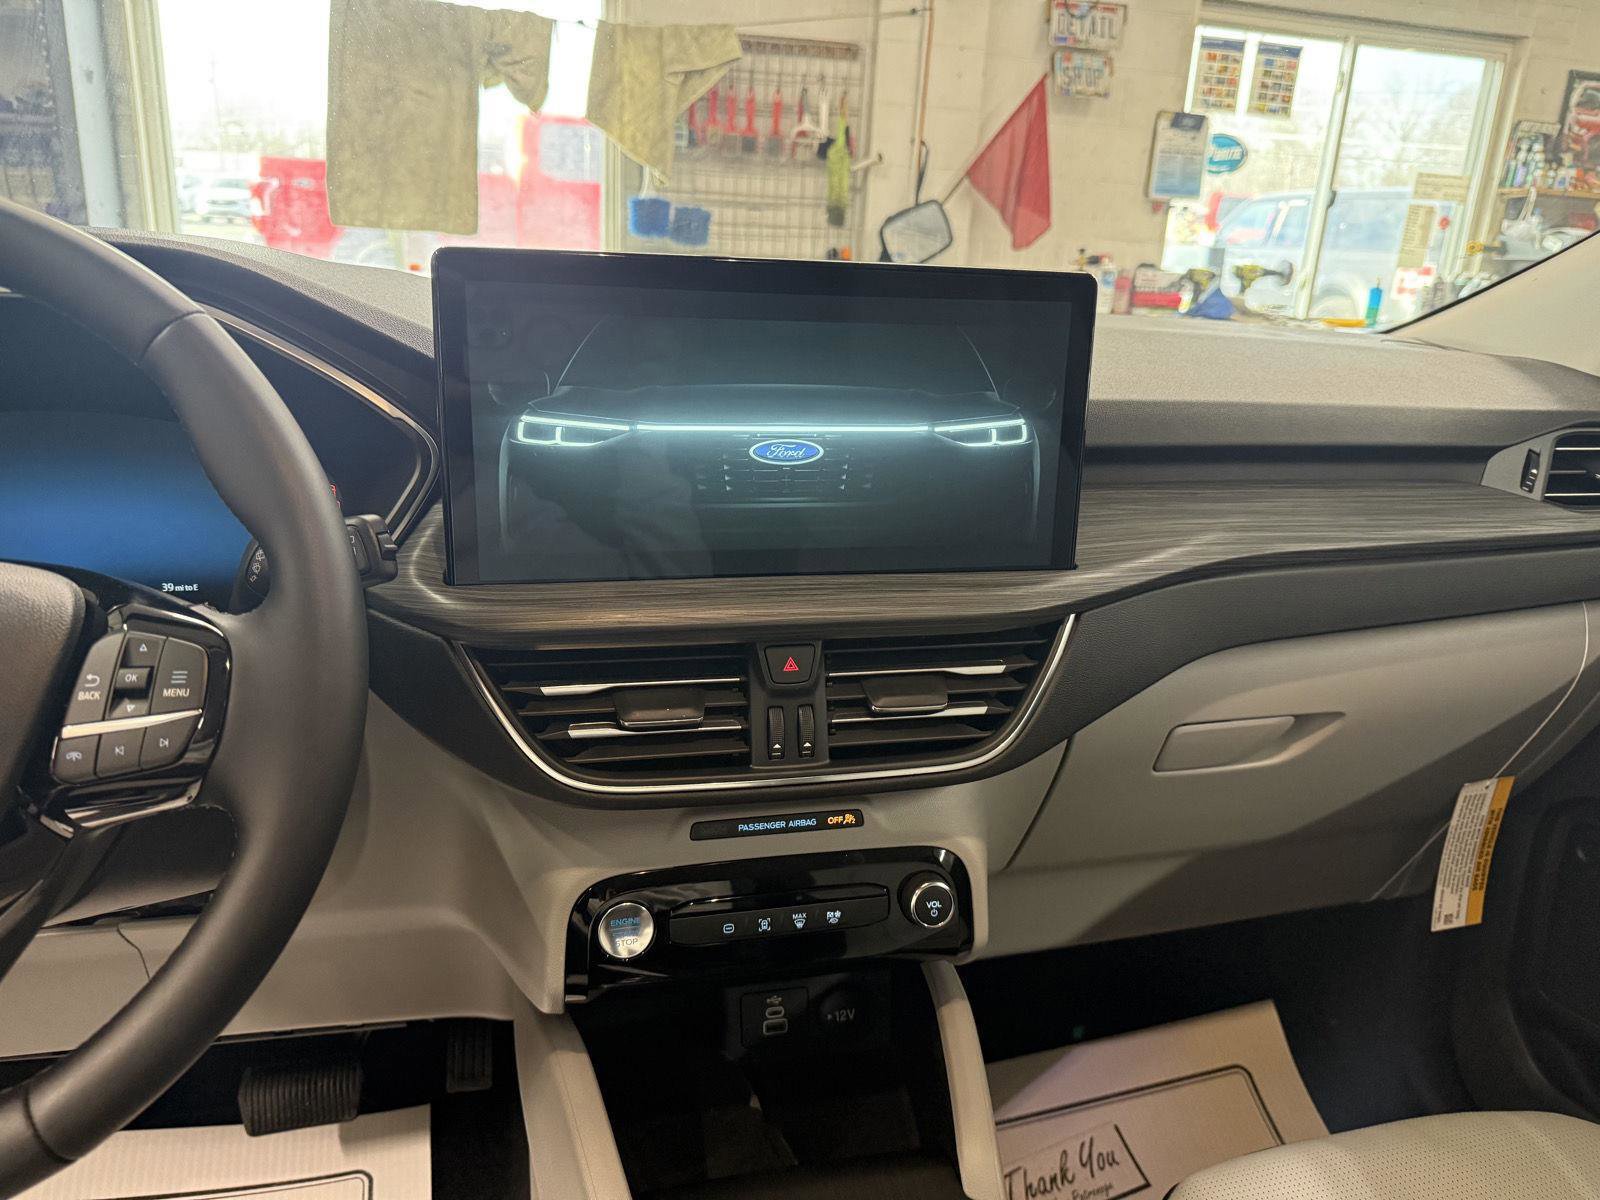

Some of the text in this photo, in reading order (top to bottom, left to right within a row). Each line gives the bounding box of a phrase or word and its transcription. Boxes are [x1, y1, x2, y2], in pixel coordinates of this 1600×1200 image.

[766, 443, 806, 458] Ford
[161, 583, 174, 592] 39
[124, 675, 138, 683] OK
[78, 690, 101, 701] BACK
[163, 687, 190, 698] MENU
[738, 816, 844, 832] PASSENGER AIRBAG OFF
[926, 900, 942, 909] VOL
[610, 916, 641, 927] ENGINE
[792, 912, 807, 920] MAX
[616, 937, 639, 947] STOP
[1004, 1136, 1120, 1200] Thank You
